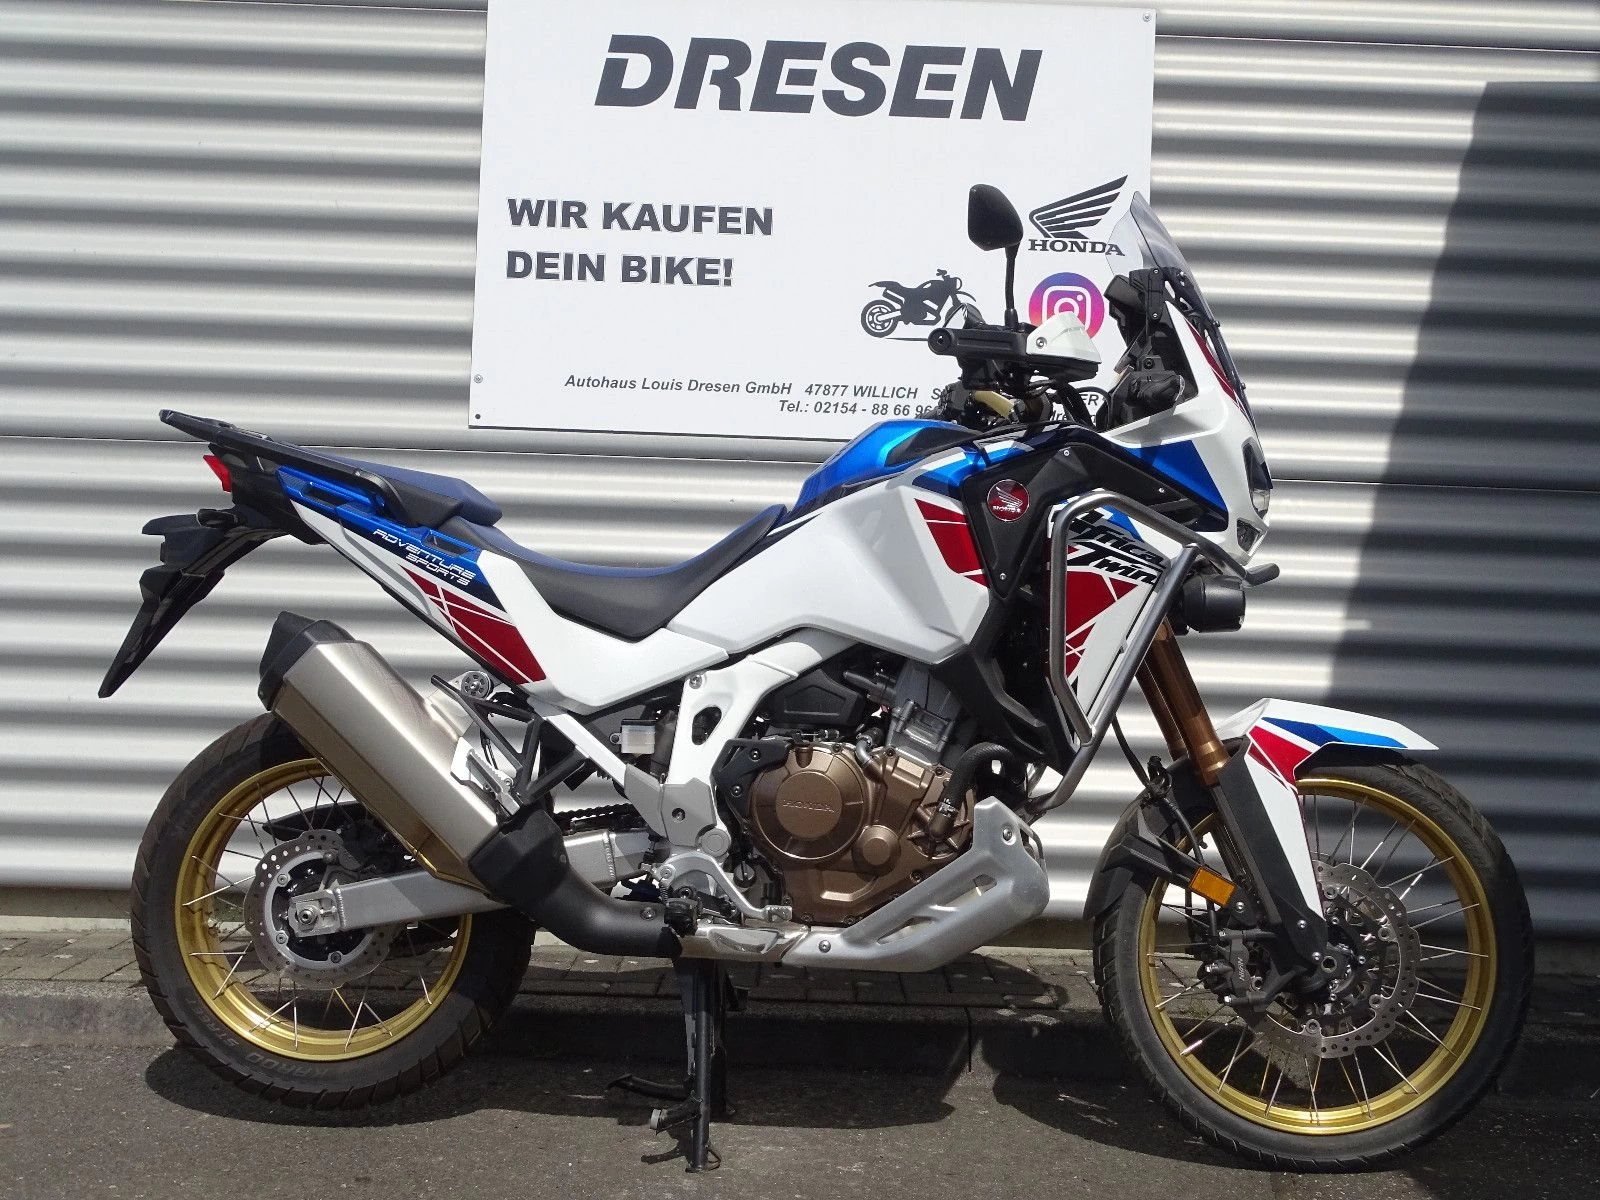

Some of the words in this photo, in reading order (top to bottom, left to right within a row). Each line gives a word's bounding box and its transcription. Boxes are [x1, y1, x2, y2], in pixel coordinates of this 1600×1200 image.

[595, 34, 1043, 121] DRESEN
[507, 198, 588, 228] WIR
[602, 202, 774, 236] KAUFEN
[1028, 239, 1125, 256] HONDA
[506, 250, 606, 282] DEIN
[621, 254, 733, 286] BIKE!
[564, 374, 637, 389] Autohaus
[641, 378, 683, 391] Louis
[687, 379, 740, 393] Dresen
[745, 381, 792, 395] GmbH
[804, 383, 849, 397] 47877
[853, 385, 918, 399] WILLICH
[779, 400, 809, 413] Tel.:
[813, 401, 857, 415] 02154
[871, 403, 889, 416] 88
[893, 404, 911, 417] 66
[373, 528, 477, 581] ADVENTURE
[405, 552, 471, 586] SPORTS
